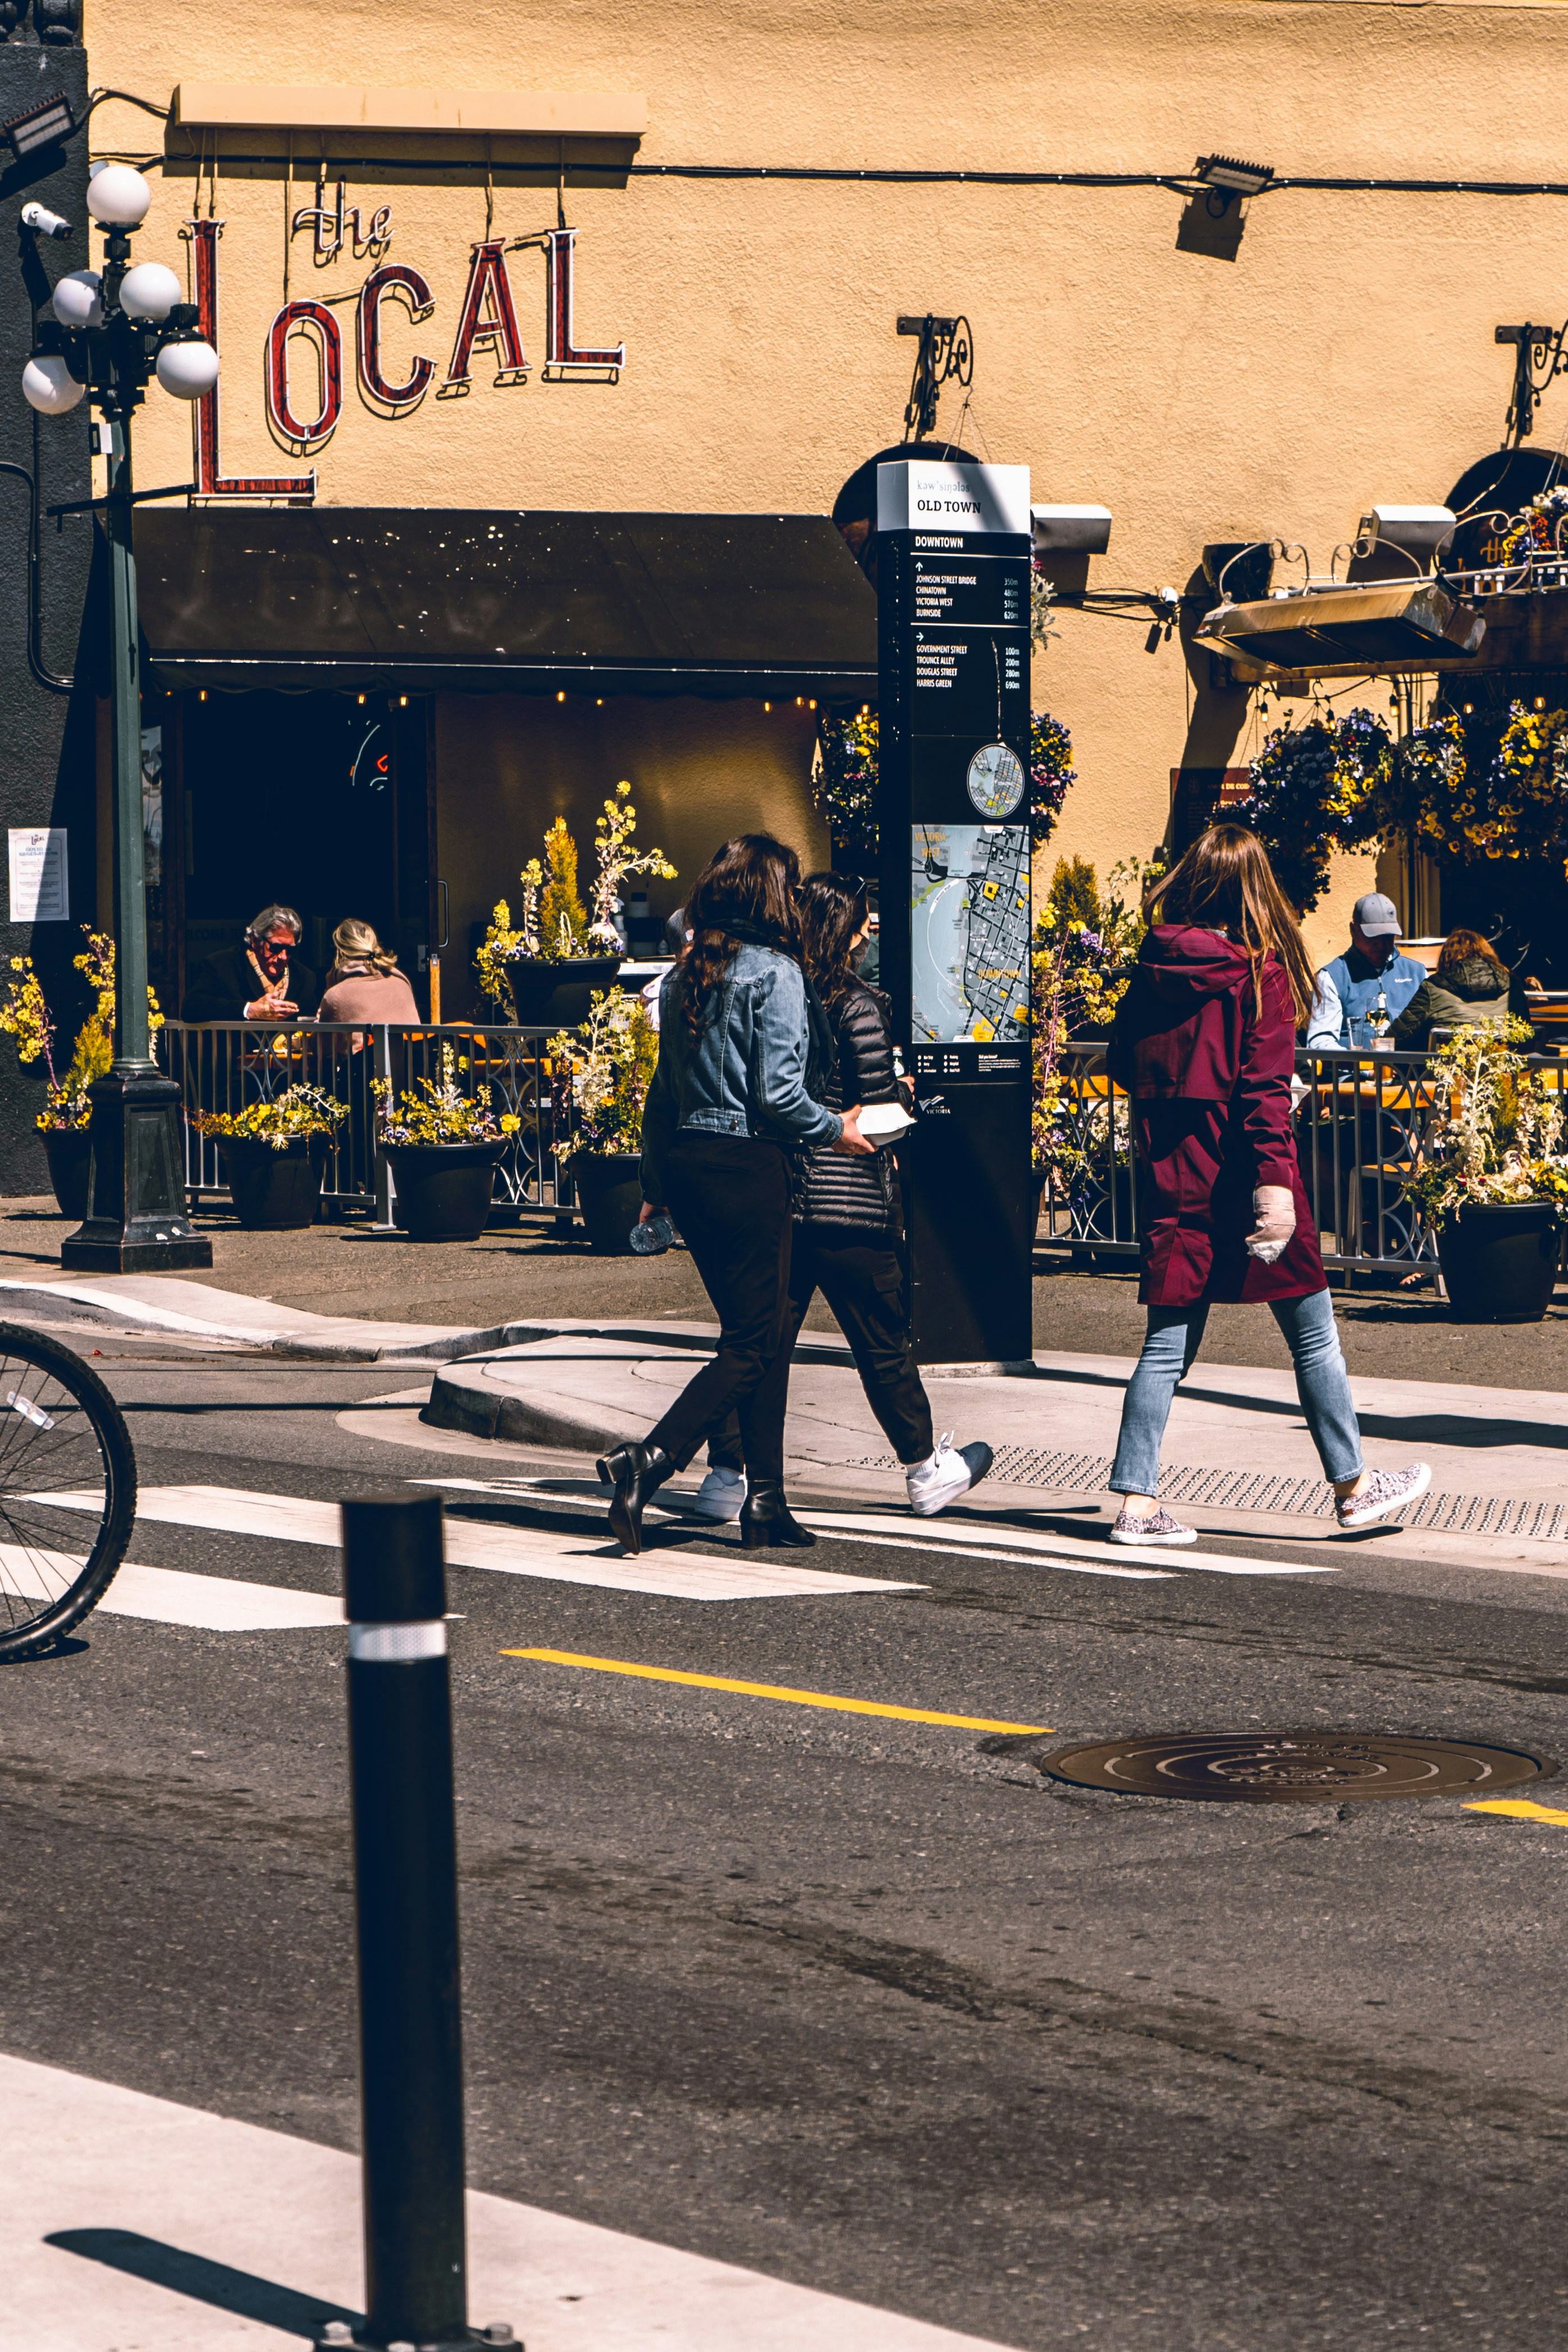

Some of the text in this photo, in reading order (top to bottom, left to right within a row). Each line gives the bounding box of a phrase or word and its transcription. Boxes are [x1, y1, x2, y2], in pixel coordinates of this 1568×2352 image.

[294, 175, 394, 255] the
[184, 219, 627, 501] LOCAL
[918, 500, 982, 514] OLD TOWN
[915, 536, 963, 548] DOWNTOWN
[1479, 536, 1505, 563] th
[959, 576, 976, 585] BRIDGE
[917, 609, 941, 617] BURNSIDE
[917, 645, 950, 653] GOVERNMENT
[915, 832, 946, 842] VICTORIA
[187, 928, 226, 941] ELCOME
[978, 969, 1022, 979] DOWNTOWN
